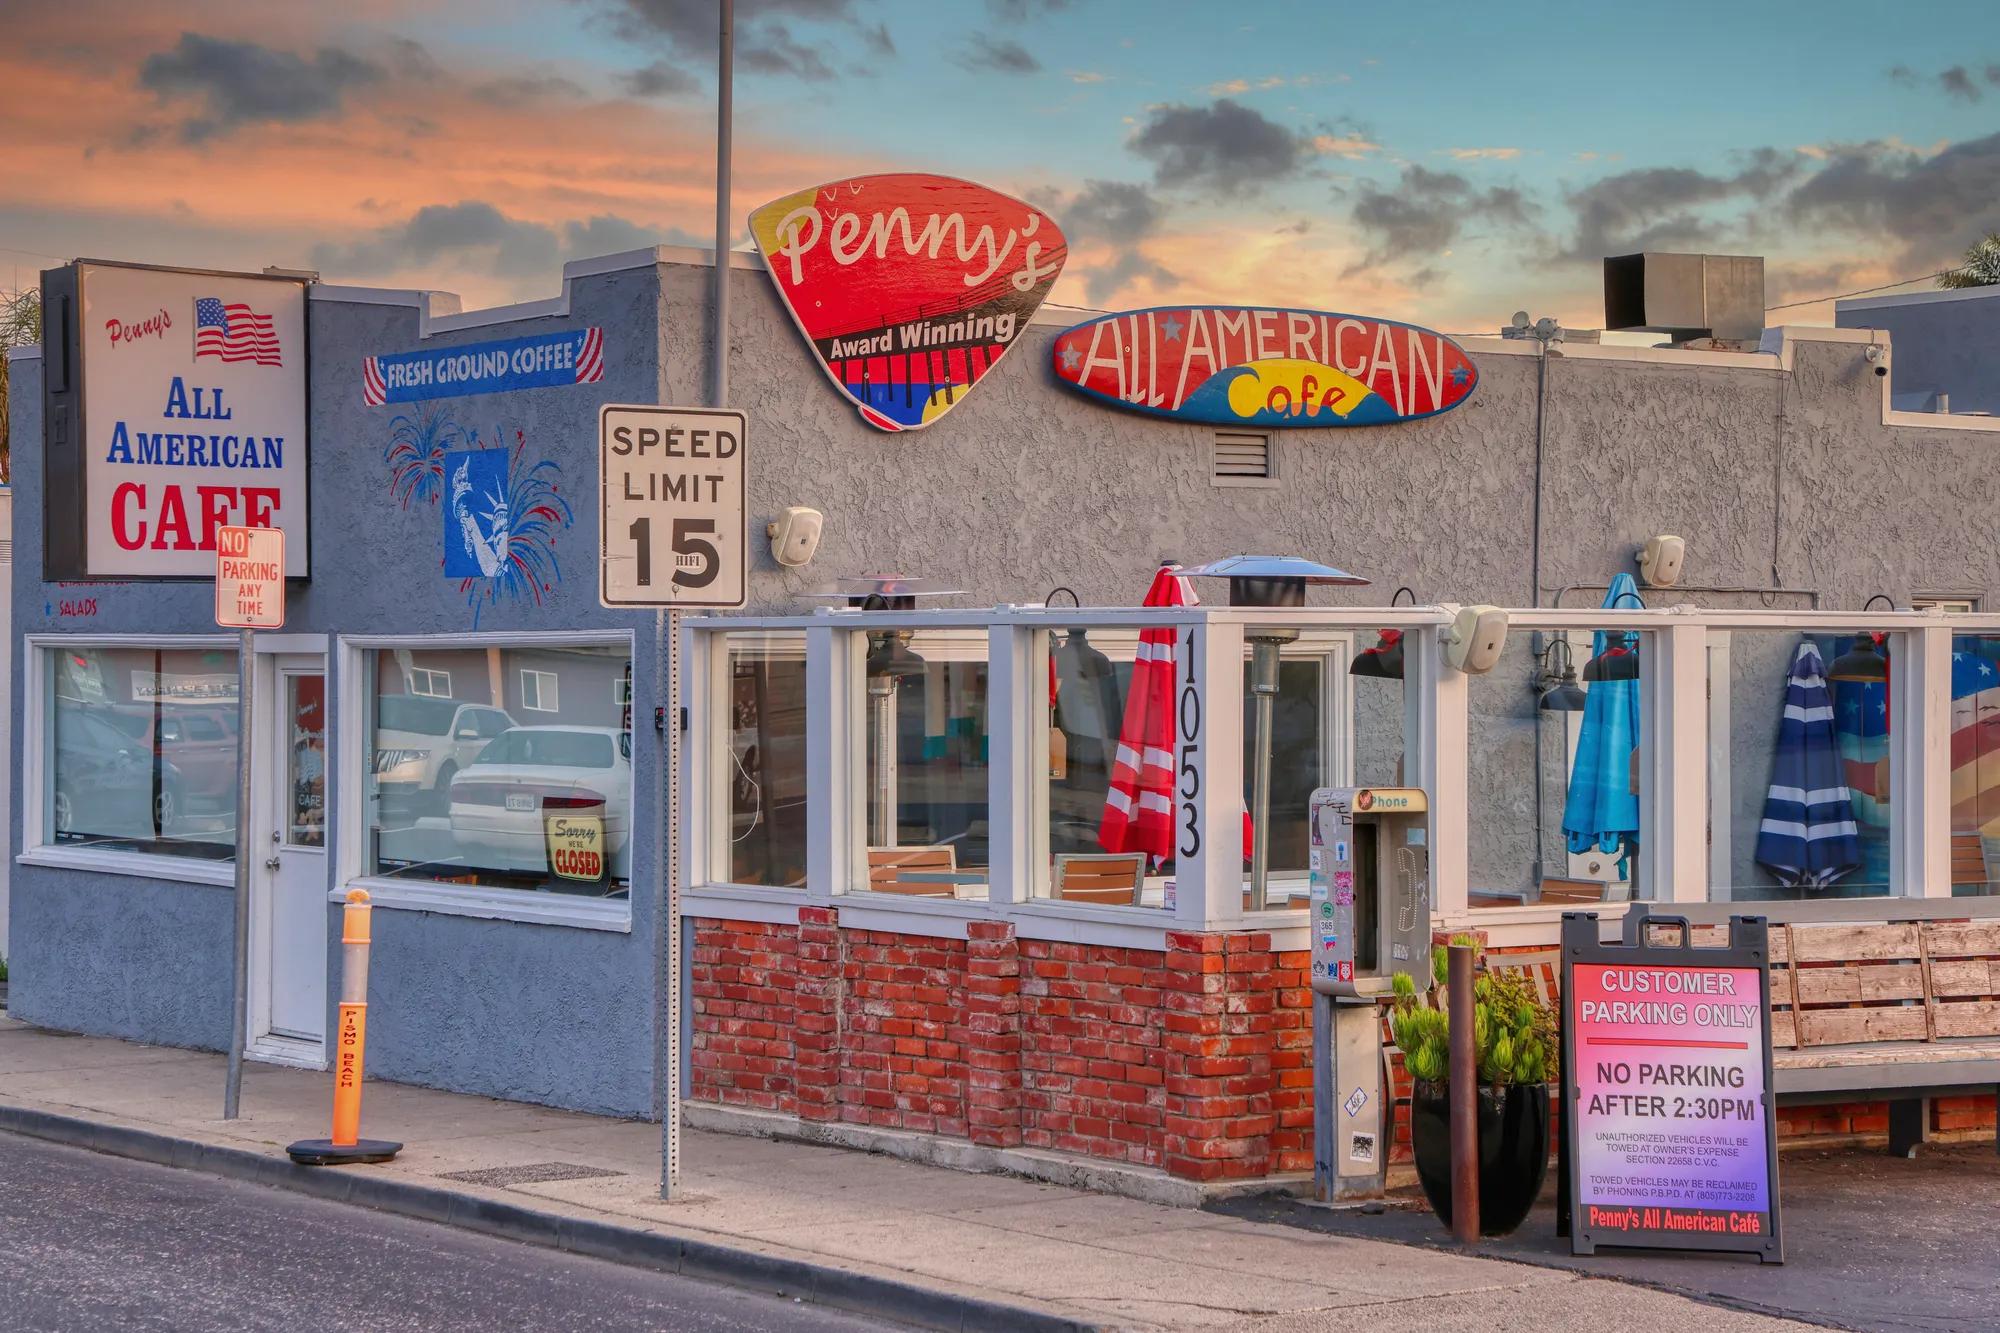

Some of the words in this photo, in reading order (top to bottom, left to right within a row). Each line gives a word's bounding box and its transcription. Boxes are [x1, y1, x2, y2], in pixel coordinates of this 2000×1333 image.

[776, 206, 1058, 292] Penny's
[105, 309, 172, 349] Penny's
[830, 329, 893, 359] Award
[900, 311, 1017, 350] Winning
[388, 359, 433, 389] FRESH
[436, 350, 509, 384] GROUND
[511, 342, 573, 374] COFFEE
[1172, 308, 1444, 416] AMERICAN
[163, 376, 231, 420] ALL
[106, 421, 284, 468] AMERICAN
[611, 426, 738, 459] SPEED
[624, 472, 724, 503] LIMIT
[222, 532, 245, 553] NO
[629, 517, 720, 589] 15
[223, 561, 278, 581] PARKING
[239, 584, 262, 597] ANY
[60, 598, 97, 616] SALADS
[237, 601, 263, 615] TIME
[1180, 628, 1200, 858] 1053
[555, 819, 596, 844] Sorry
[556, 849, 601, 876] CLOSED
[1321, 922, 1333, 930] 365
[1601, 970, 1736, 995] CUSTOMER
[344, 1011, 357, 1045] PISMO
[1581, 1001, 1687, 1025] PARKING
[1694, 1004, 1758, 1028] ONLY
[341, 1053, 354, 1087] BEACH
[1597, 1063, 1631, 1084] NO
[1639, 1064, 1744, 1088] PARKING
[1588, 1094, 1667, 1118] AFTER
[1674, 1097, 1755, 1121] 2:30PM
[1596, 1133, 1665, 1143] UNAUTHORIZED
[1668, 1135, 1712, 1145] VEHICLES
[1714, 1137, 1735, 1146] WILL
[1737, 1138, 1748, 1147] BE
[1606, 1144, 1638, 1153] TOWED
[1641, 1145, 1652, 1153] AT
[1653, 1145, 1695, 1155] OWNER'S
[1698, 1147, 1739, 1157] EXPENSE
[1626, 1155, 1665, 1165] SECTION
[1667, 1156, 1692, 1166] 22658
[1590, 1176, 1623, 1185] TOWED
[1625, 1177, 1669, 1187] VEHICLES
[1671, 1178, 1690, 1188] MAY
[1691, 1180, 1704, 1188] BE
[1706, 1180, 1758, 1191] RECLAIMED
[1593, 1187, 1604, 1195] BY
[1607, 1188, 1649, 1197] PHONING
[1684, 1191, 1695, 1199] AT
[1590, 1206, 1639, 1232] Penny's
[1643, 1208, 1660, 1229] All
[1664, 1209, 1726, 1233] American
[1729, 1212, 1760, 1234] Café
